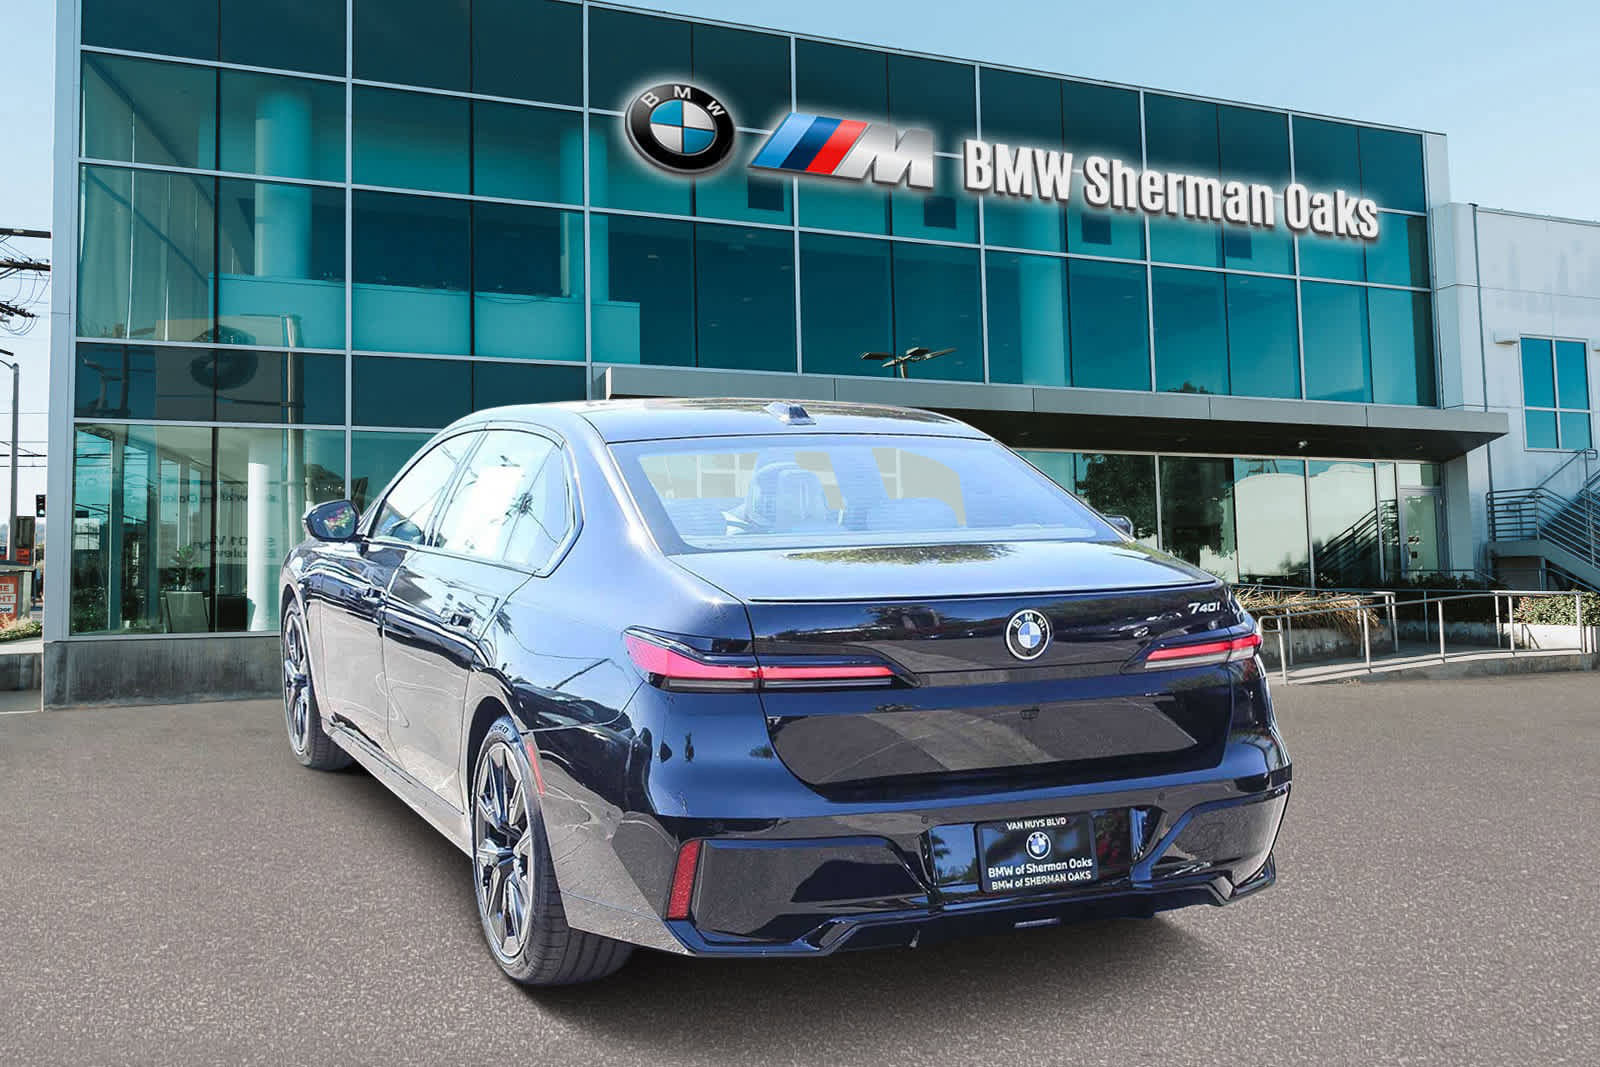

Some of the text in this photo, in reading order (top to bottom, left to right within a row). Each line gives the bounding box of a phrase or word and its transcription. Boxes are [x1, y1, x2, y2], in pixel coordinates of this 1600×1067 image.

[641, 85, 725, 117] BMW
[963, 139, 1380, 242] BMW Sherman Oaks
[1012, 612, 1045, 629] BMW
[1006, 816, 1067, 830] VAN NUYS BLVD
[988, 857, 1093, 878] BMW of Sherman Oaks
[991, 870, 1092, 891] BMW of SHERMAN OAKS
